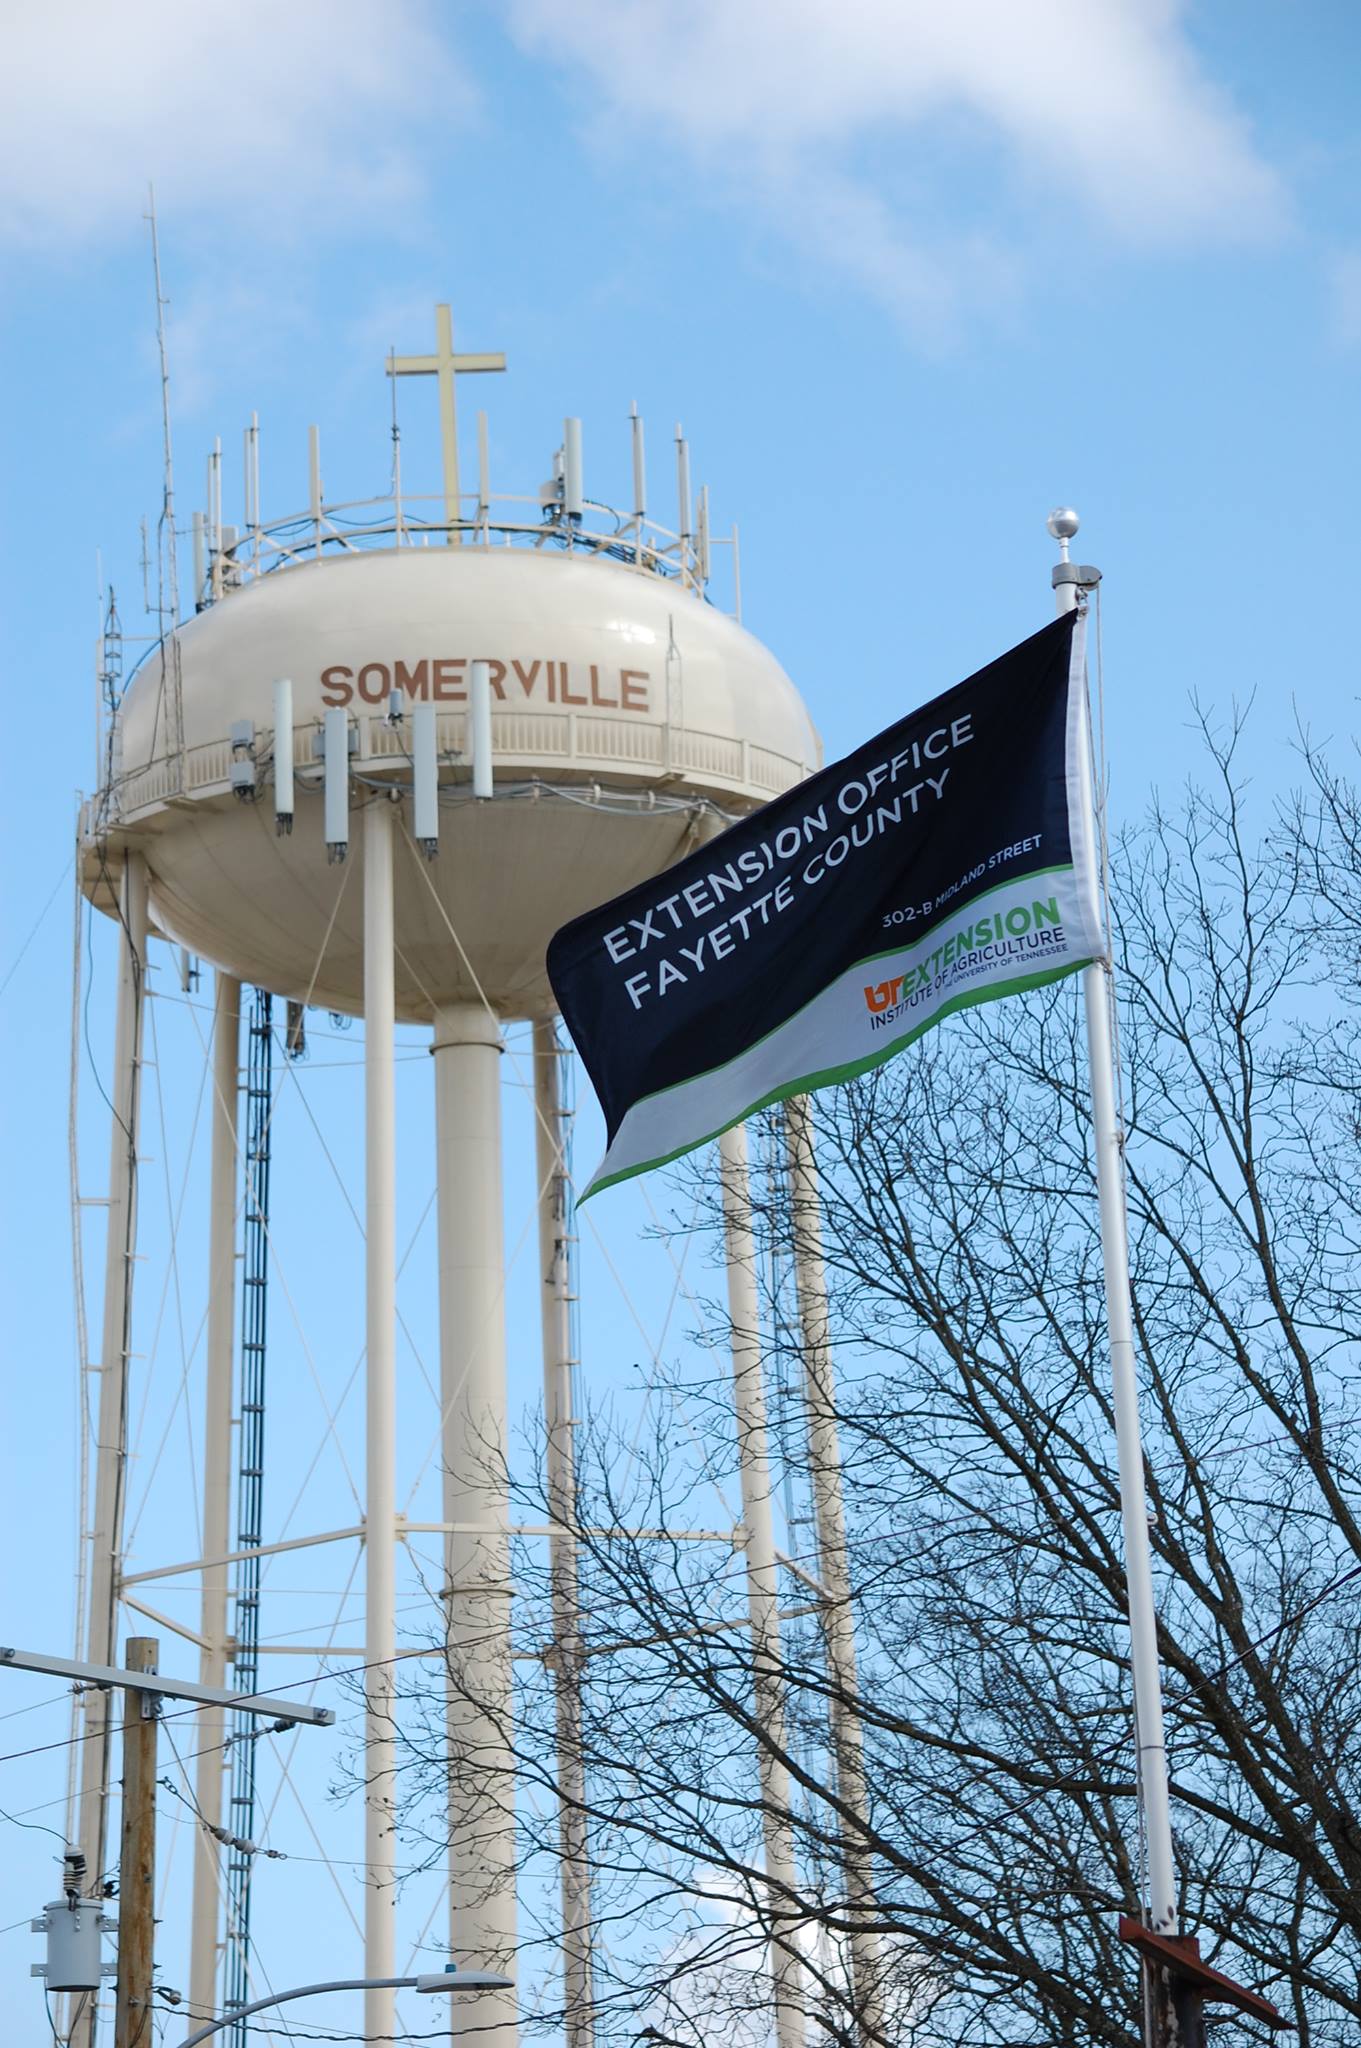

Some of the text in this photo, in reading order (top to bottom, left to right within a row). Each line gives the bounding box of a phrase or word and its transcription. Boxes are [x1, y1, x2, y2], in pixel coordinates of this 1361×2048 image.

[320, 659, 649, 712] SOMERVILLE
[603, 713, 974, 964] EXTENSION OFFICE
[624, 768, 951, 1010] FAYETTE COUNTY
[882, 833, 1043, 928] 302-B MIDLAND STREET
[870, 927, 1066, 1031] INSTITUTE OF AGRICULTURE
[902, 897, 1061, 999] EXTENSION
[953, 943, 1069, 984] UNIVERSITY OF TENNESSEE
